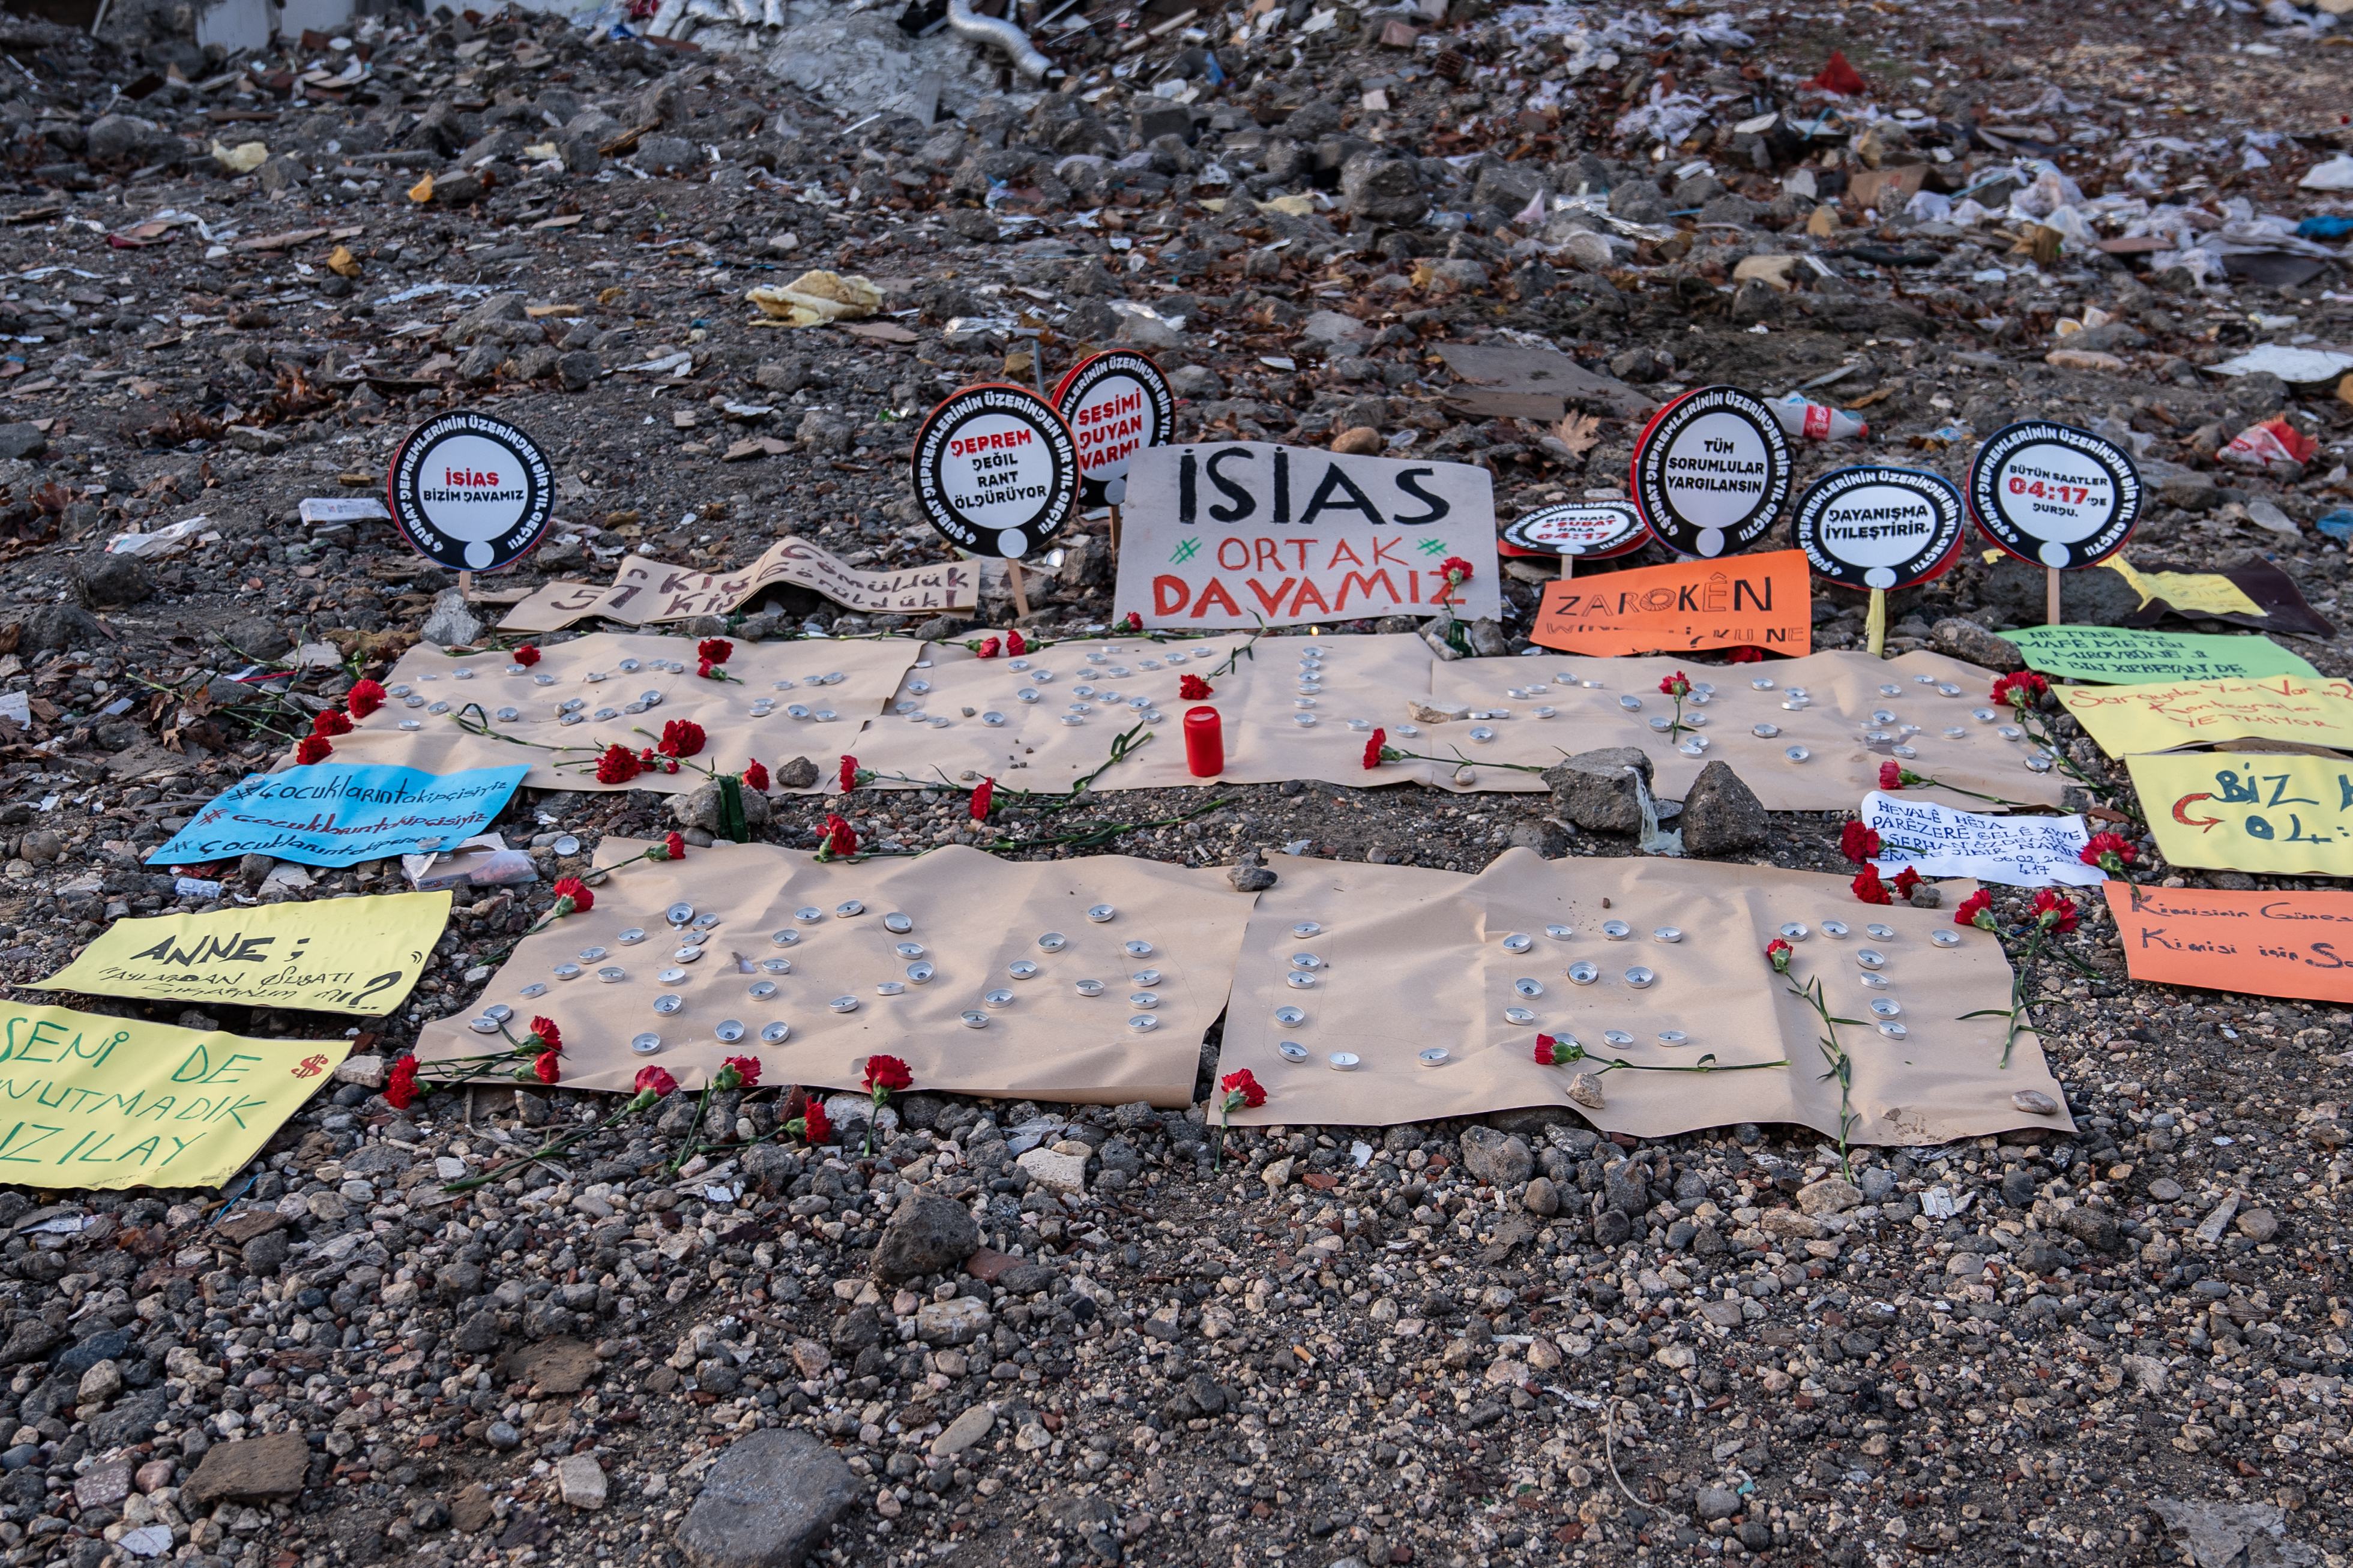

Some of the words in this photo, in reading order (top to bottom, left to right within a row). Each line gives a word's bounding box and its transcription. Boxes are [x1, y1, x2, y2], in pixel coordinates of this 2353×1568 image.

[1109, 356, 1164, 392] ÜZERİNDEN
[1062, 361, 1108, 421] EMLERİNİN
[984, 391, 1062, 438] ÜZERİNDEN
[1079, 387, 1142, 427] SESİMİ
[1156, 390, 1172, 418] BİR
[1158, 418, 1170, 439] YIL
[1725, 390, 1783, 448] ÜZERİNDEN
[468, 415, 540, 464] ÜZERİNDEN
[951, 429, 1032, 458] DEPREM
[1079, 414, 1142, 451] DUYAN
[1645, 392, 1724, 481] DEPREMLERİNİN
[400, 415, 466, 500] DEPREMLERİNİN
[920, 396, 983, 499] DEPREMLERİNİN
[1055, 435, 1073, 464] BİR
[1704, 437, 1734, 454] TÜM
[2059, 428, 2132, 478] ÜZERİNDEN
[1668, 457, 1765, 475] SORUMLULAR
[1775, 449, 1791, 476] BİR
[1978, 425, 2057, 493] DEPREMLERİNİN
[445, 467, 499, 488] İSİAS
[532, 462, 550, 487] BİR
[977, 470, 1019, 488] RANT
[1060, 464, 1073, 490] YIL
[1178, 445, 1451, 526] İSİAS
[1667, 476, 1762, 493] YARGILANSIN
[1879, 470, 1951, 503] ÜZERİNDEN
[2010, 464, 2050, 479] BÜTÜN
[2052, 473, 2108, 486] SAATLER
[423, 488, 460, 502] BİZİM
[464, 490, 524, 502] DAVAMIZ
[535, 488, 549, 510] YIL
[954, 485, 1047, 509] ÖLDÜRÜYOR
[1770, 478, 1787, 502] YIL
[2120, 476, 2139, 500] BİR
[1645, 483, 1672, 530] ŞUBAT
[1799, 470, 1877, 539] DEPREMLERİNİN
[1828, 505, 1929, 522] DAYANIŞMA
[1941, 499, 1960, 519] BİR
[1978, 494, 2010, 536] ŞUBAT
[2033, 503, 2078, 517] DURDU.
[2118, 501, 2137, 521] YIL
[401, 502, 434, 547] ŞUBAT
[926, 499, 965, 540] ŞUBAT
[1668, 525, 1679, 536] 6
[1941, 517, 1957, 538] YIL
[433, 541, 443, 553] 6
[965, 532, 977, 544] 6
[1536, 532, 1610, 540] 04:17
[2007, 533, 2019, 543] 6
[1217, 536, 1409, 572] ORTAK
[1800, 540, 1834, 571] ŞUBAT
[1831, 566, 1843, 576] 6
[1152, 568, 1468, 619] DAVAMIZ
[1555, 572, 1773, 617] ZAROKÊN
[1766, 627, 1803, 643] NE
[2092, 640, 2138, 648] ME
[2214, 664, 2248, 673] DE
[2258, 679, 2315, 696] Var
[2214, 762, 2320, 808] BİZ
[1878, 801, 1942, 823] HEVALÊ
[1872, 816, 1971, 839] PARÊZERÊ
[2037, 827, 2082, 840] XWE
[1889, 834, 1966, 850] SERHAN
[1878, 851, 1911, 861] EM
[2130, 893, 2250, 918] Kimisinin
[2141, 927, 2238, 954] Kimisi
[2258, 945, 2298, 961] için
[171, 1044, 262, 1084] DE
[0, 1079, 267, 1129] NUTMADIK
[0, 1121, 207, 1167] IZILAY
